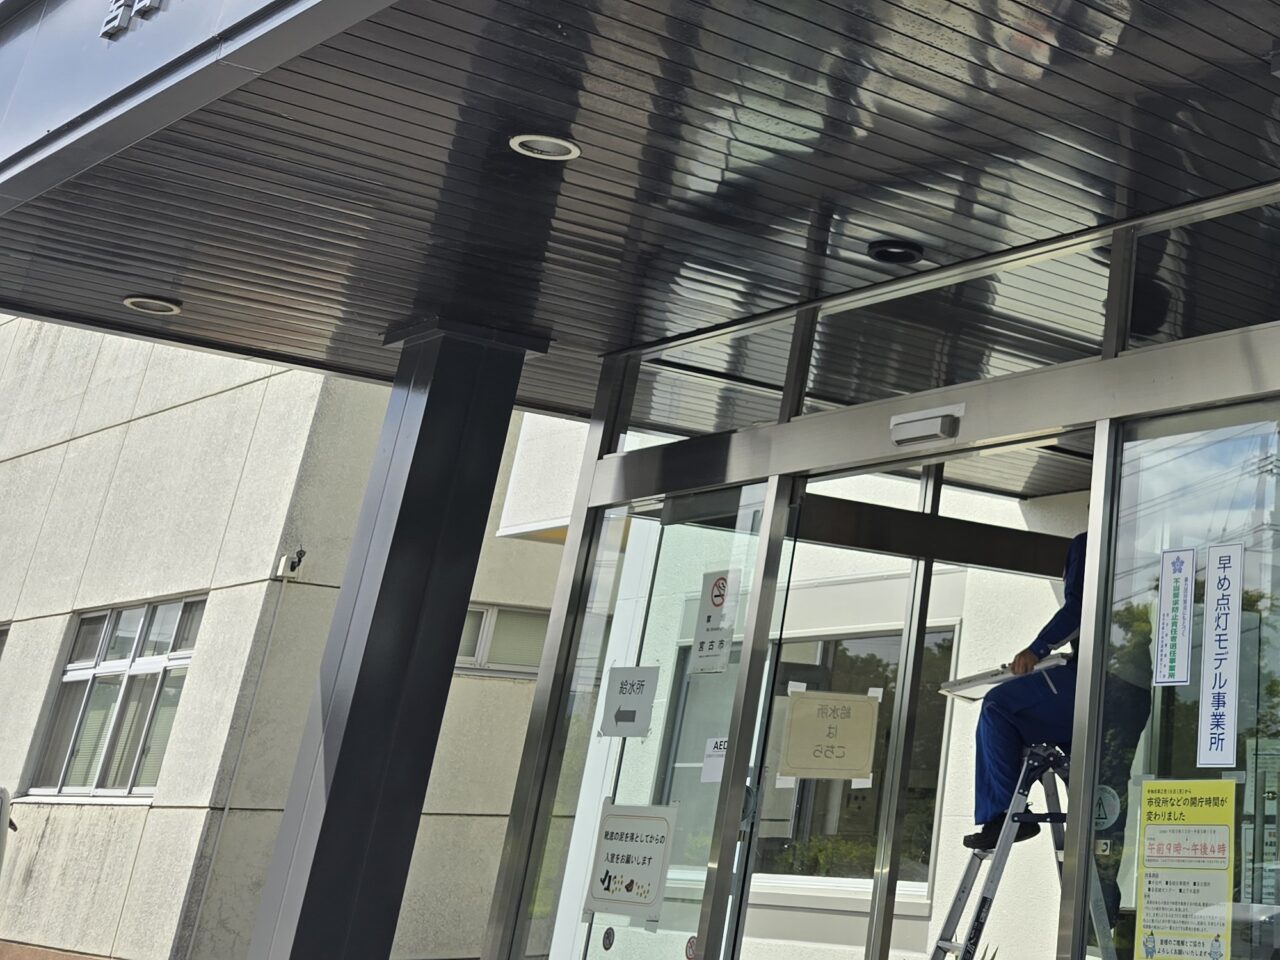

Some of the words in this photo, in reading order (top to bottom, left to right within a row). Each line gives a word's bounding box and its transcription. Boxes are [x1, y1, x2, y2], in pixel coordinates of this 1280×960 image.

[1208, 555, 1232, 752] 早め点灯モデル事業所
[619, 680, 646, 695] 給水所
[1146, 796, 1228, 808] 市役所などの開庁時間が
[1146, 811, 1186, 821] 変わりました
